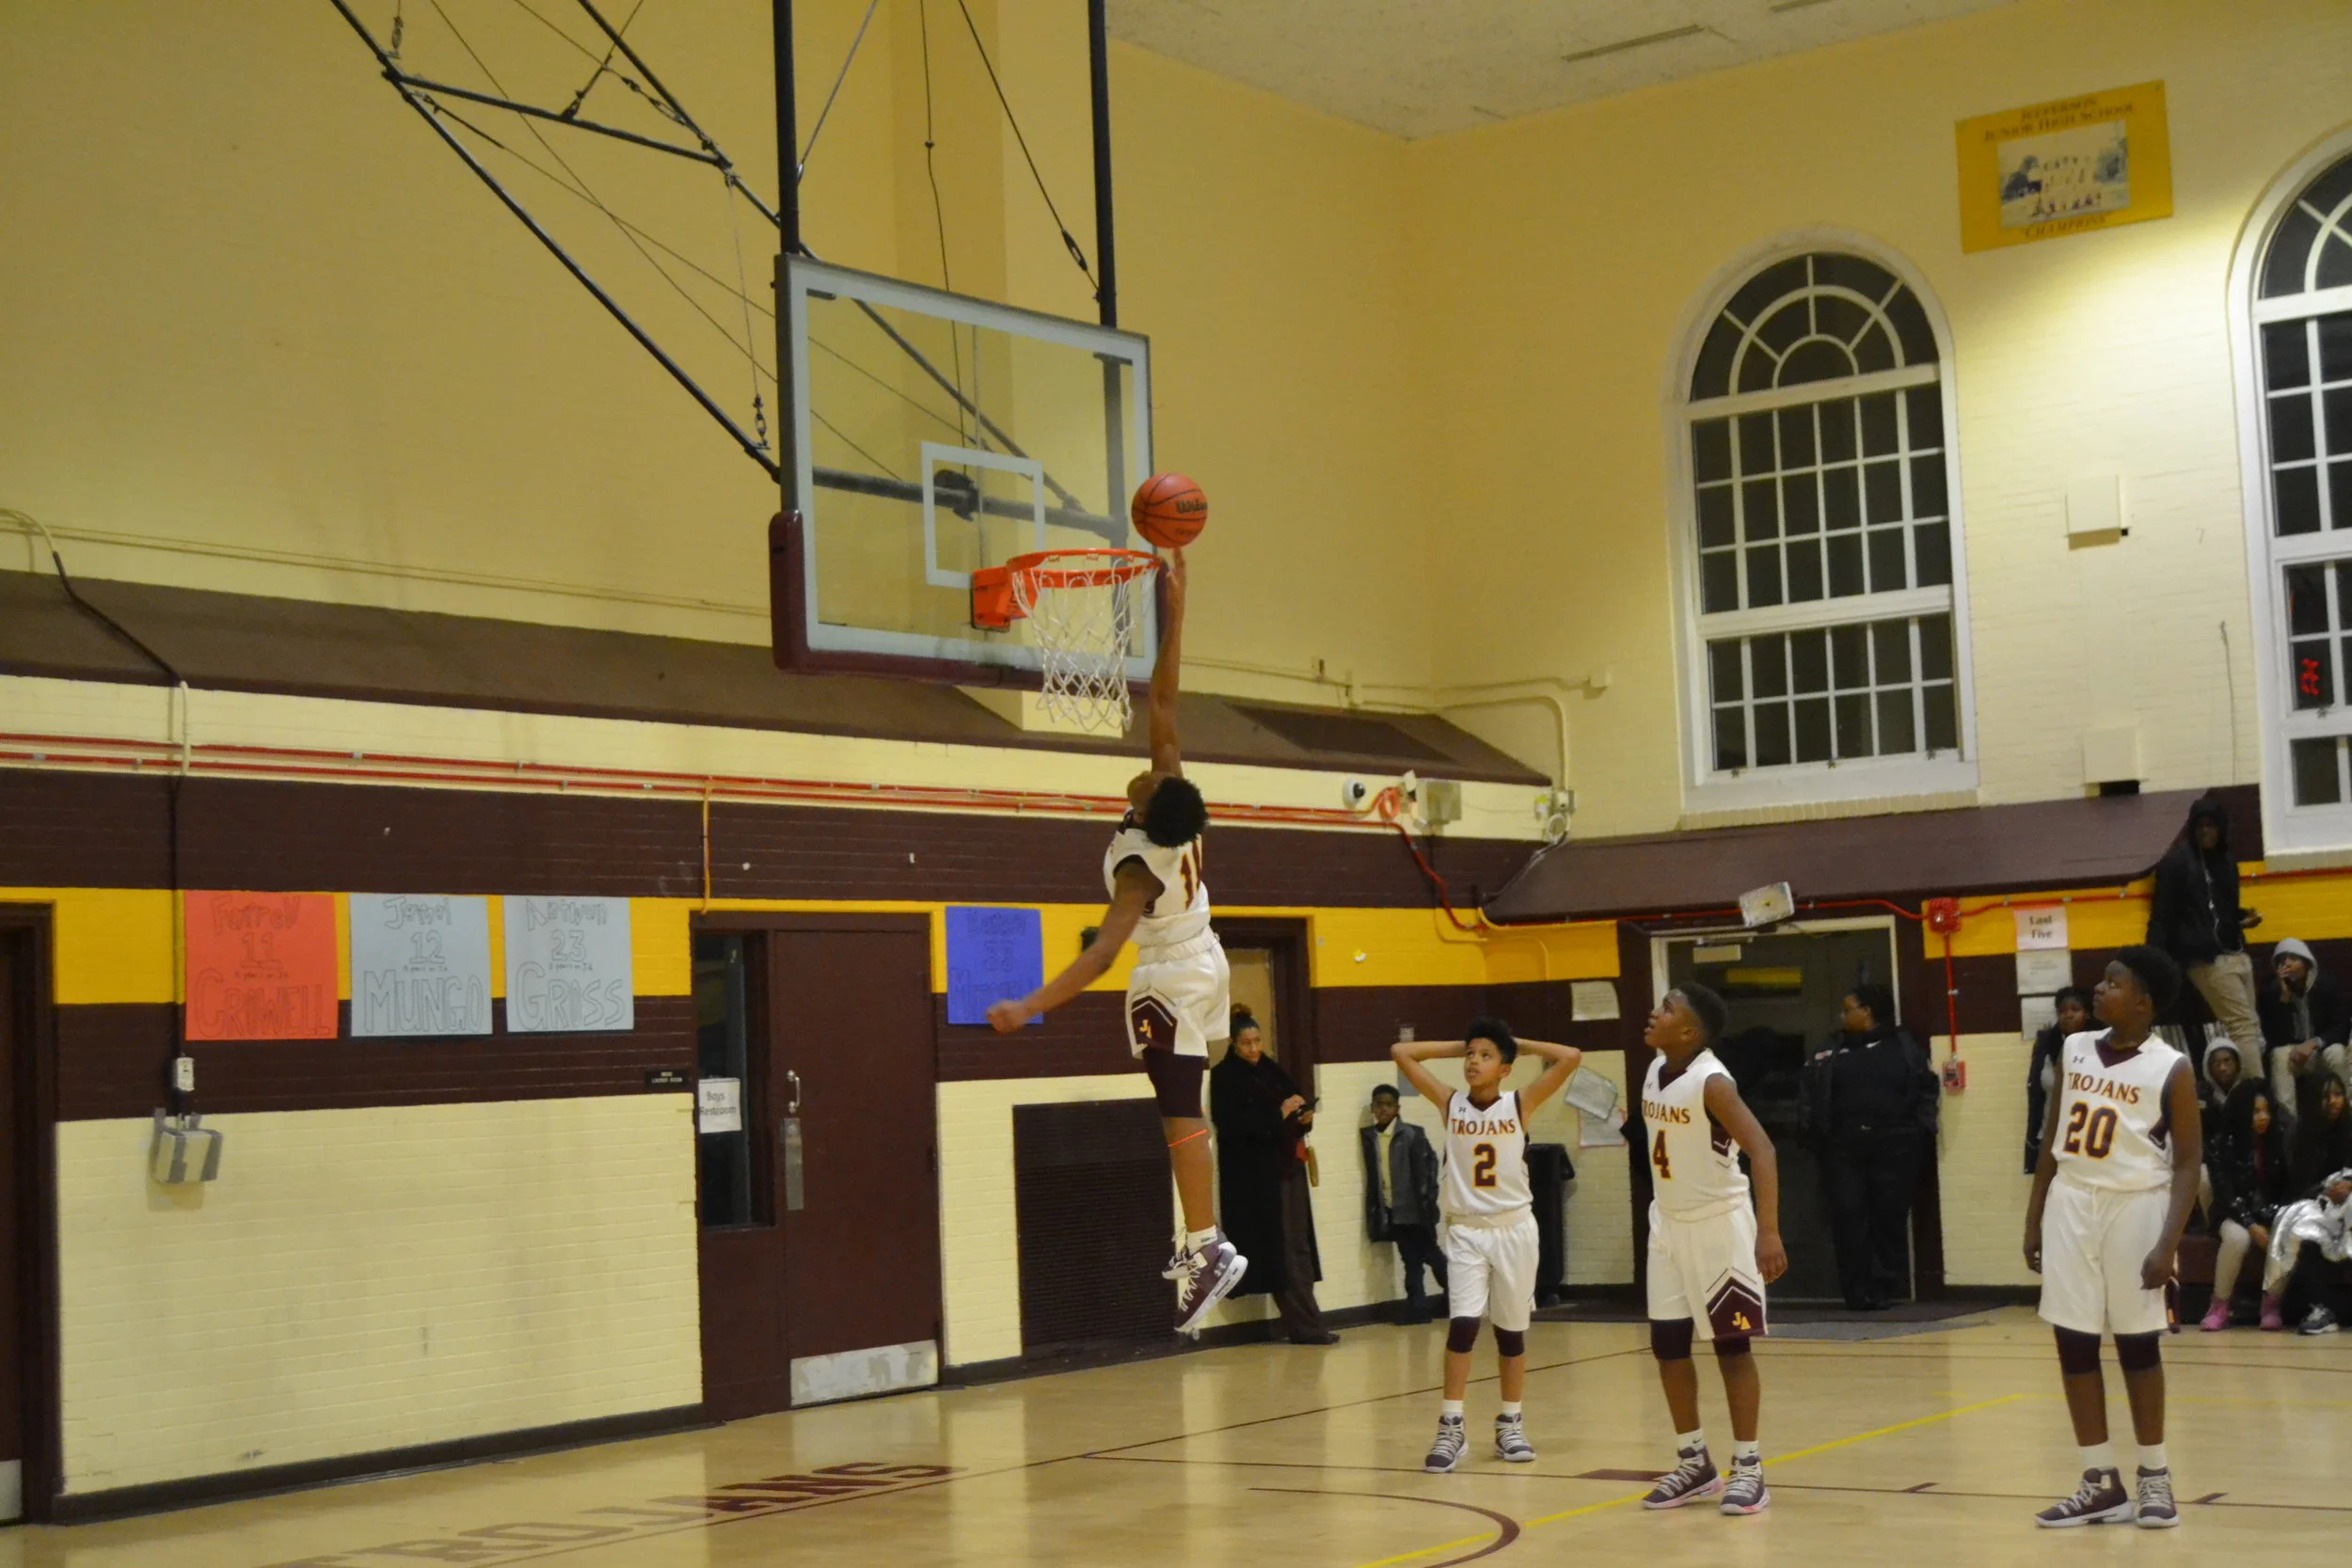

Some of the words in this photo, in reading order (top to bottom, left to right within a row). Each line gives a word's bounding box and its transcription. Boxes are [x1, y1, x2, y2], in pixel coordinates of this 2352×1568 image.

[240, 930, 283, 969] 11
[409, 929, 446, 965] 12
[550, 928, 587, 962] 23
[364, 969, 485, 1034] MUNGO
[2069, 1071, 2141, 1105] TROJANS
[1451, 1117, 1517, 1135] TROJANS
[1642, 1099, 1692, 1125] ROJANS
[2062, 1100, 2119, 1159] 20
[1473, 1142, 1497, 1188] 2
[1652, 1129, 1672, 1180] 4
